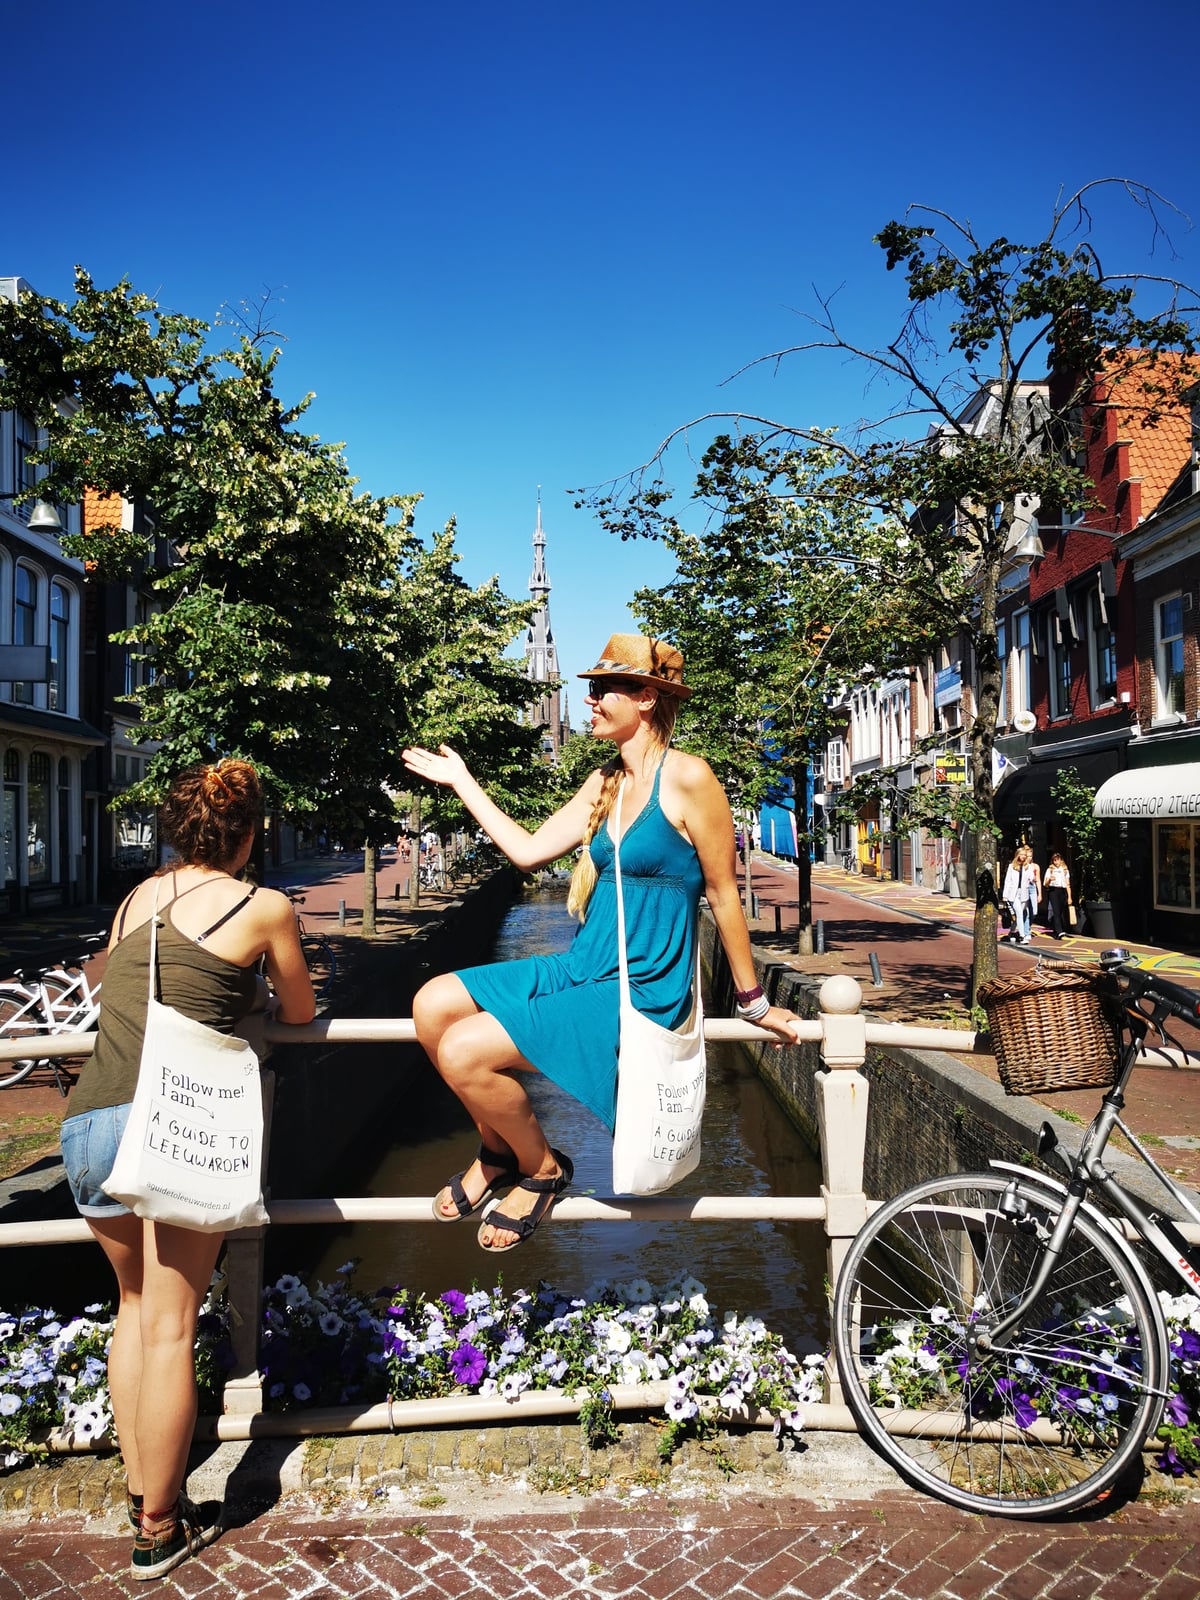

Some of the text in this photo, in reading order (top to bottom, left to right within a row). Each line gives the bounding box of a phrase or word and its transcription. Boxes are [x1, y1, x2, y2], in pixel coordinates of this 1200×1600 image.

[1100, 797, 1164, 815] VINTAGESHOP
[162, 1066, 244, 1099] Follow me!
[657, 1083, 689, 1099] Follow
[161, 1082, 195, 1107] I am
[659, 1098, 683, 1113] I am
[152, 1111, 160, 1126] A
[229, 1135, 250, 1150] TO
[654, 1126, 661, 1138] A
[149, 1131, 249, 1173] LEEUWARDEN
